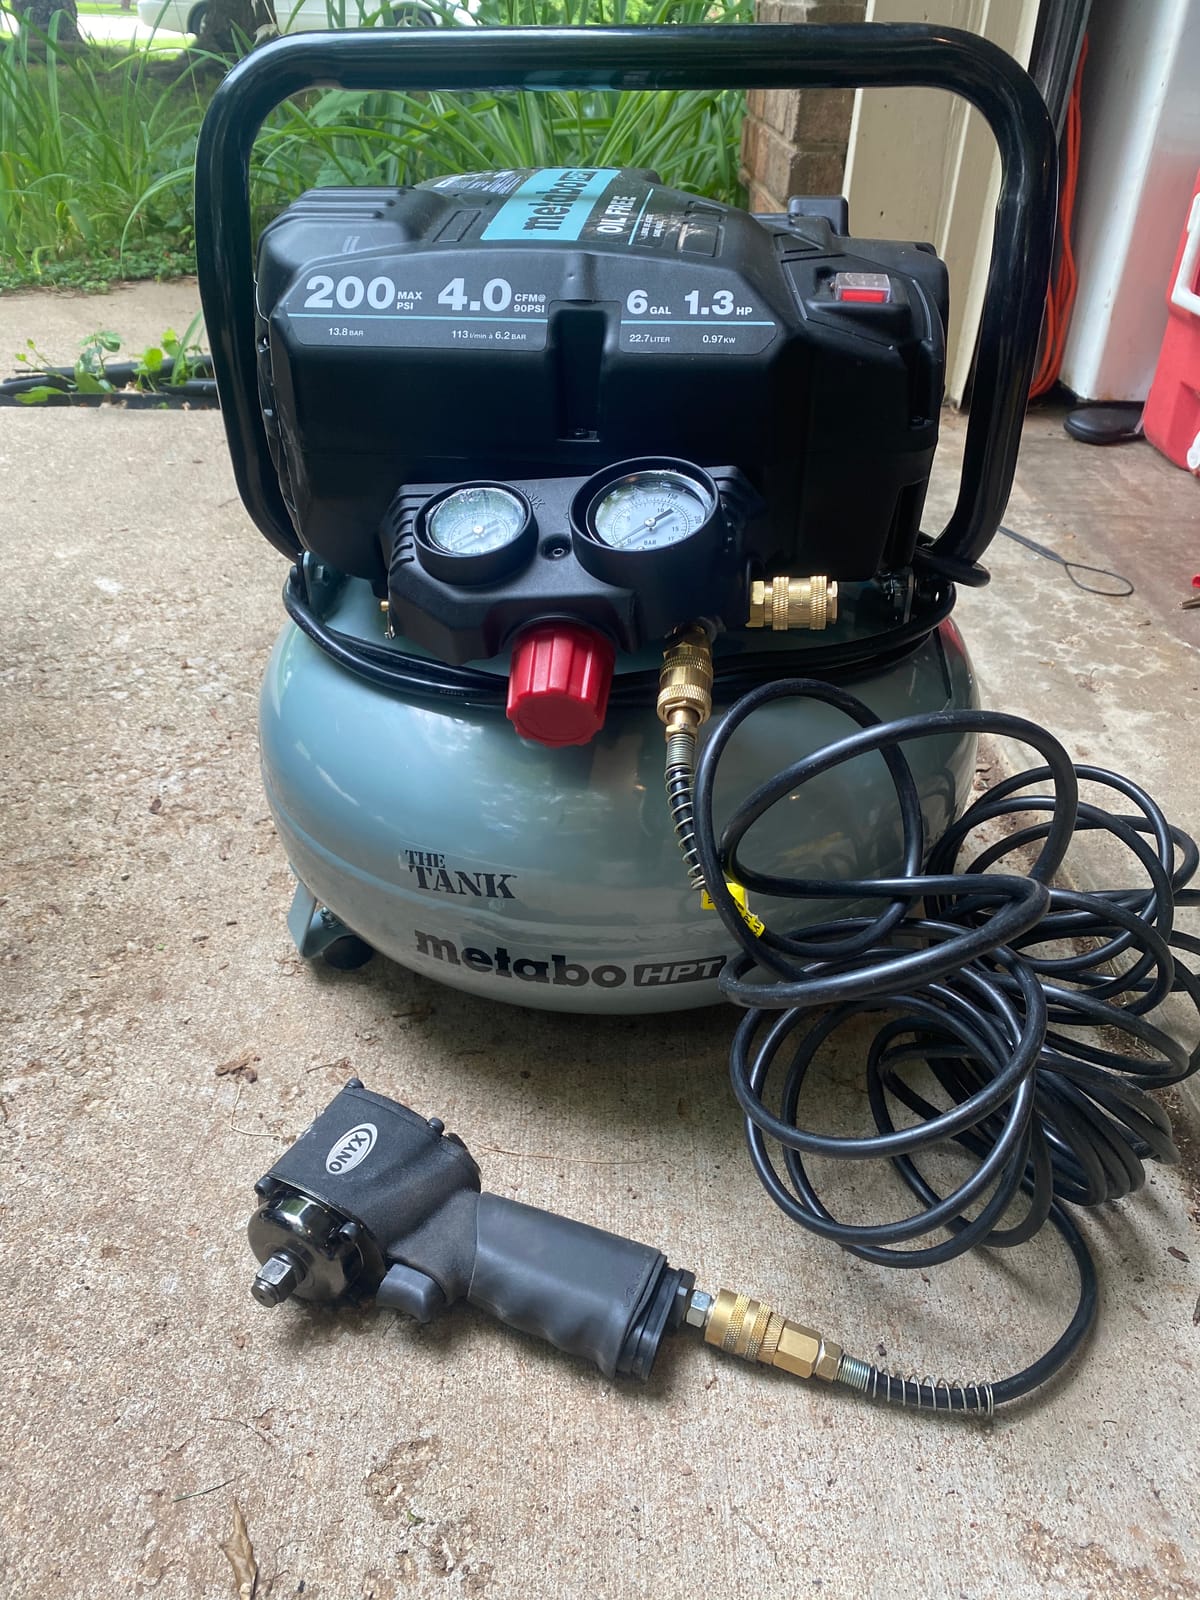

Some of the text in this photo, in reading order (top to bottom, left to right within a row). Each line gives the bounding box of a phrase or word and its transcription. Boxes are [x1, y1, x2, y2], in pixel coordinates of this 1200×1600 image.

[522, 181, 588, 230] metabo
[596, 195, 637, 233] OIL FREE
[303, 275, 423, 311] 200 MAX PSI
[437, 277, 547, 314] 4.0 CFM@ 90PSI
[626, 289, 672, 315] 6 GAL
[684, 289, 753, 316] 1.3 HP
[328, 327, 364, 337] 13.8 BAR
[451, 329, 469, 339] 113
[494, 330, 510, 340] 6.2
[629, 334, 650, 343] 22.7
[702, 334, 724, 344] 0.97
[405, 849, 446, 869] THE
[408, 866, 518, 900] TANK
[414, 930, 724, 989] metabo HPT
[329, 1134, 368, 1172] ONYX
